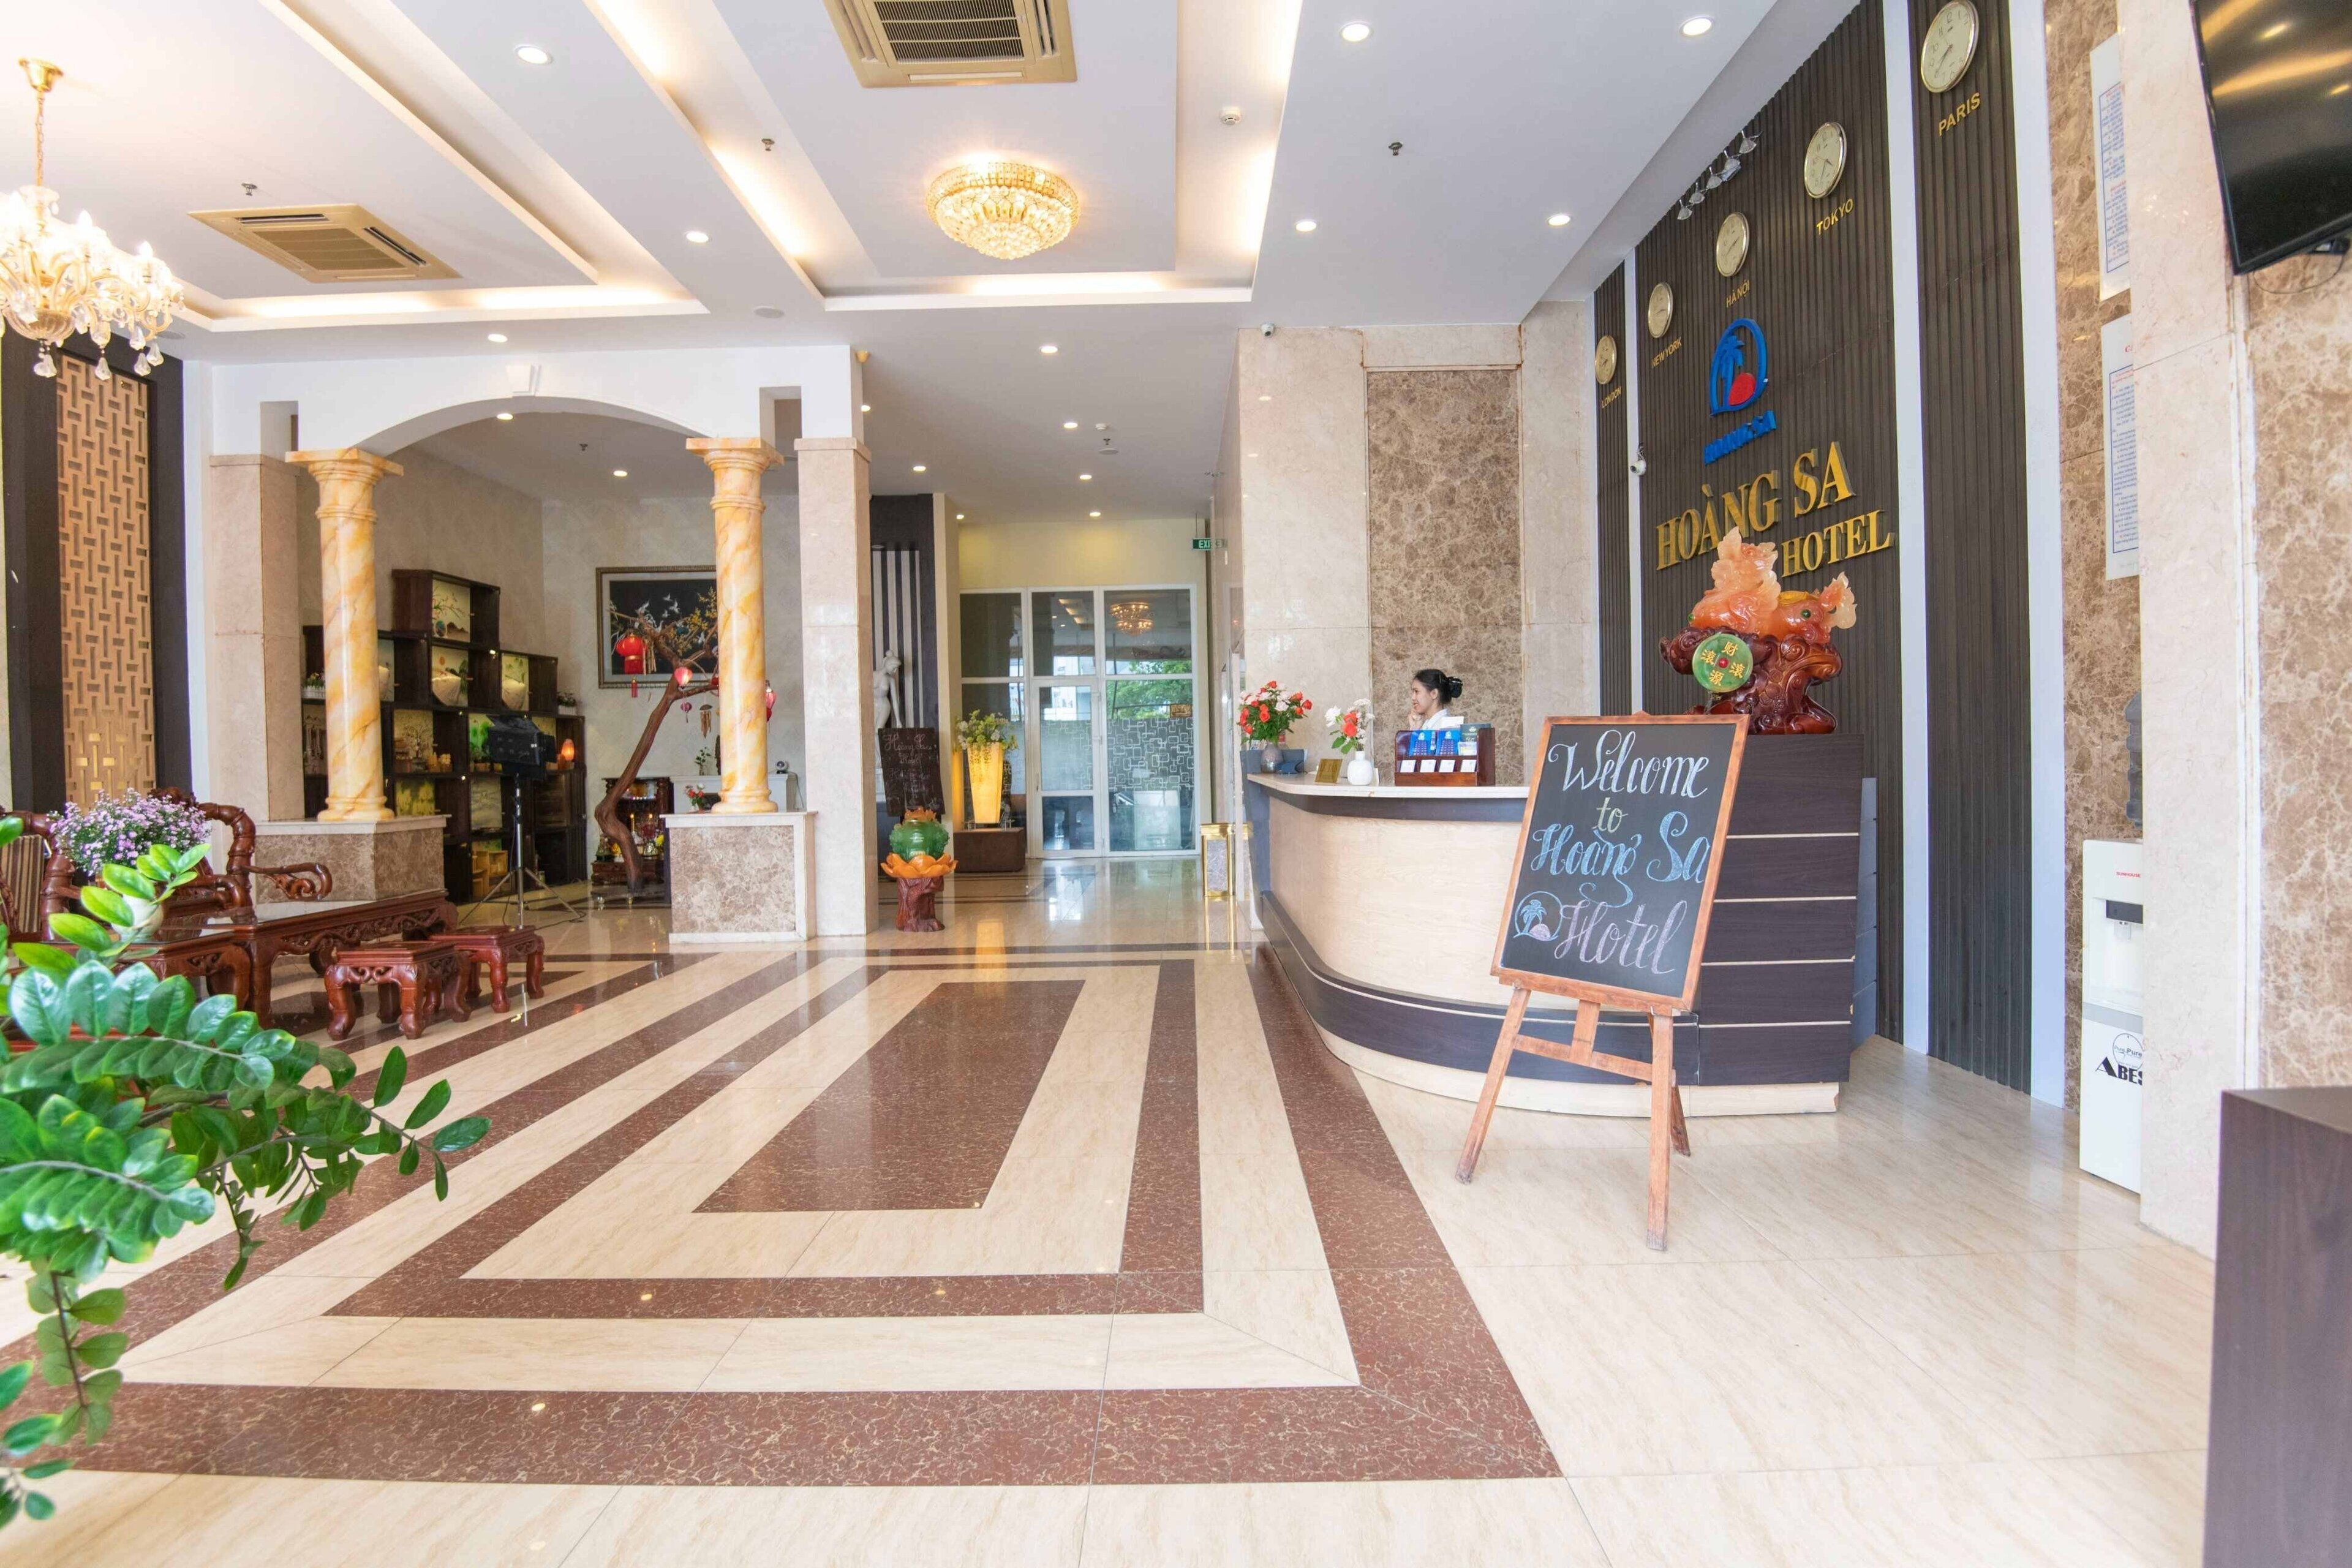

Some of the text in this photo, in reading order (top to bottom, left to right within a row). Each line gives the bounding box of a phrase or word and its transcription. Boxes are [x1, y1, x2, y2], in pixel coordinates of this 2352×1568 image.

[1939, 92, 1981, 137] PARIS
[1816, 198, 1854, 235] TOKYO
[1602, 386, 1621, 409] LONDON
[1656, 442, 1855, 570] HOÀNG SA
[1781, 510, 1895, 578] HOTEL
[1548, 729, 1709, 798] Welcome
[1592, 797, 1628, 833] to
[1646, 811, 1711, 883] Sa
[1554, 899, 1688, 974] Hotel
[2127, 1048, 2143, 1057] Pure
